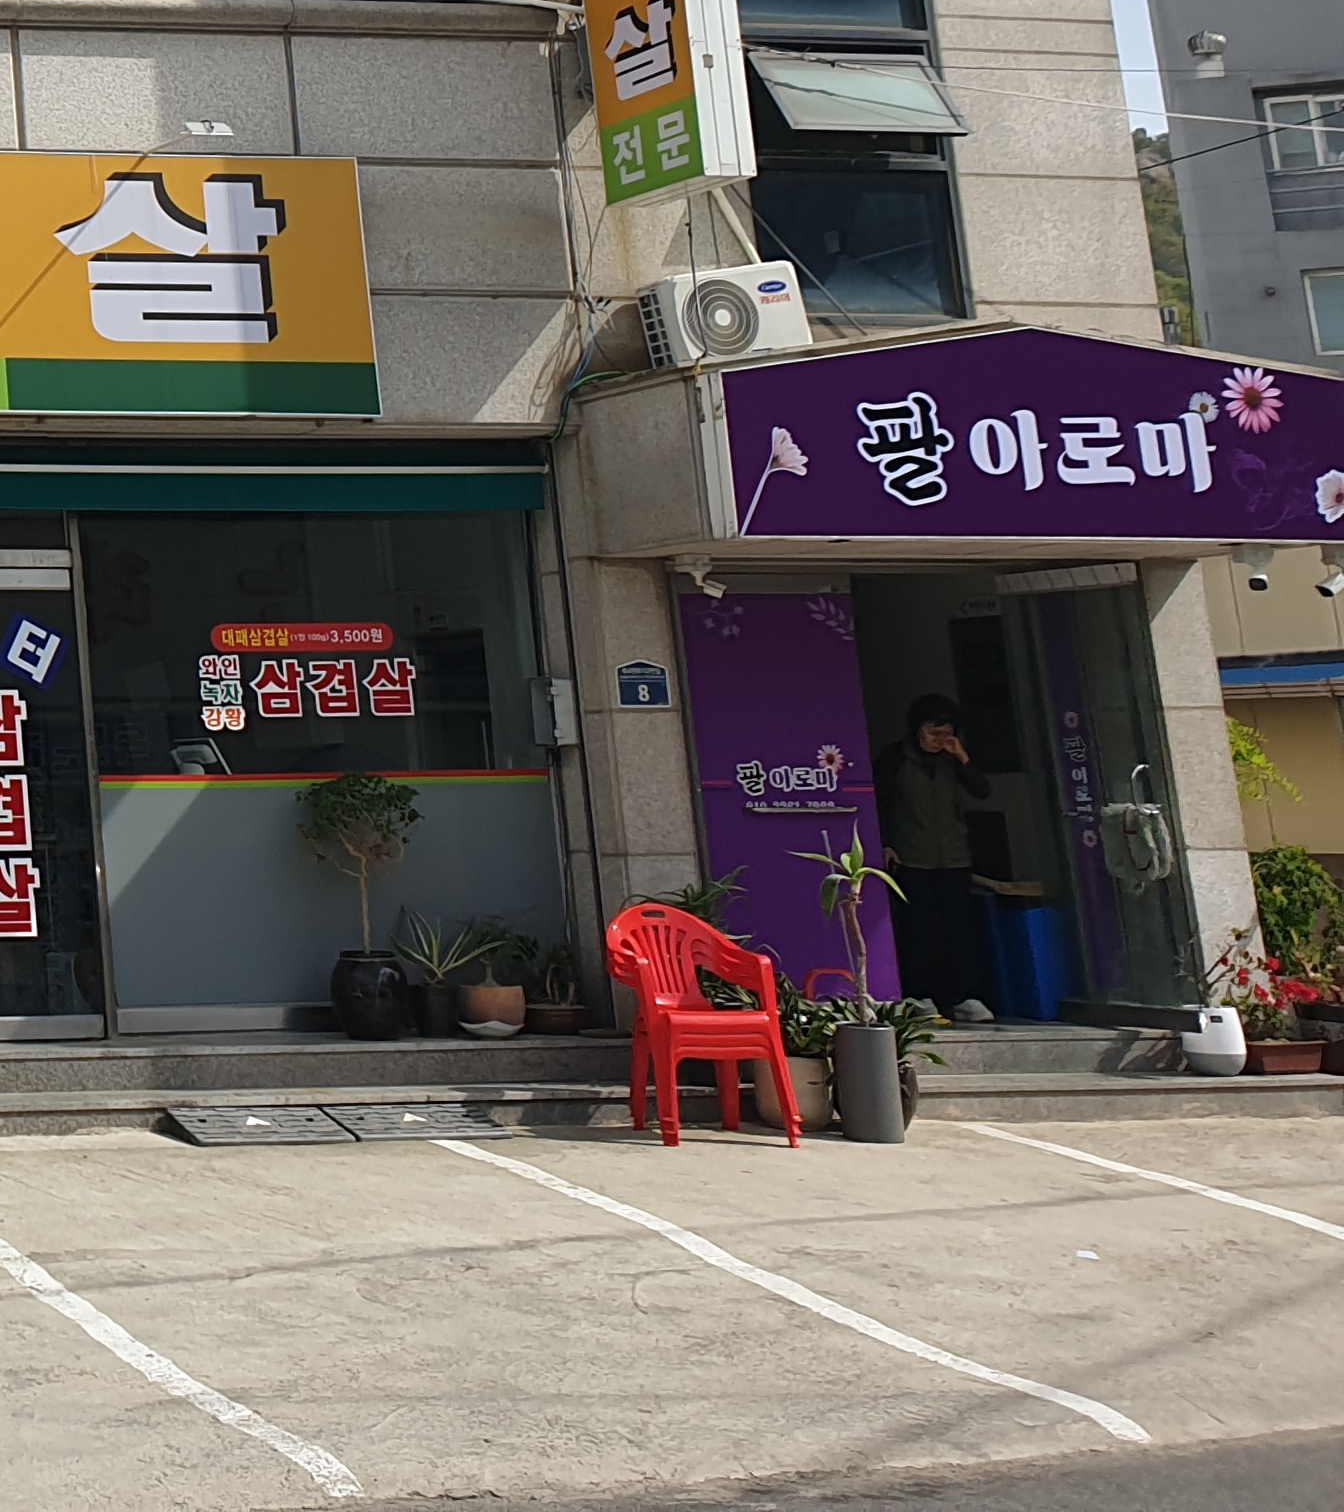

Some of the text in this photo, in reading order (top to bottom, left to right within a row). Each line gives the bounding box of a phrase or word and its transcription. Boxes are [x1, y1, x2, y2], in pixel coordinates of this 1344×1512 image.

[612, 110, 689, 185] 전문
[969, 409, 1217, 493] 아로마
[198, 654, 240, 679] 와인
[201, 681, 242, 705] 녹차
[249, 657, 416, 717] 삼겹살
[638, 684, 650, 702] 8
[201, 706, 245, 731] 강황
